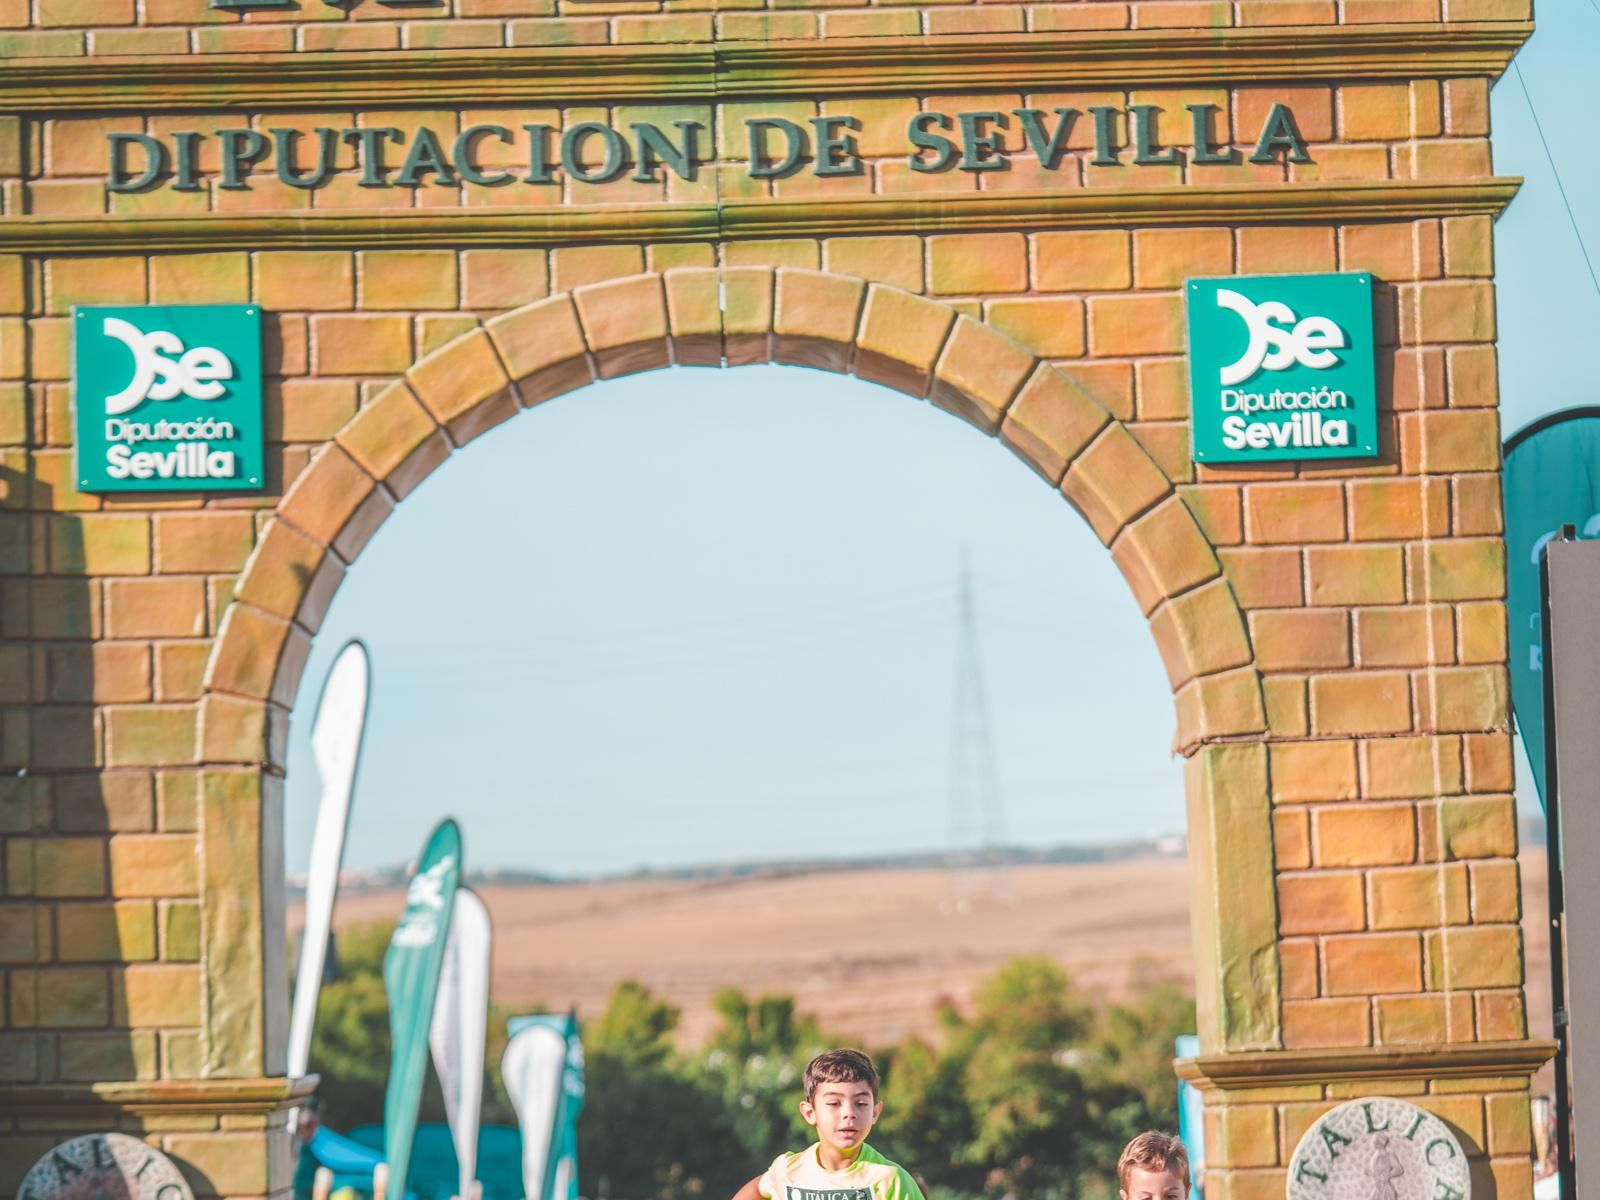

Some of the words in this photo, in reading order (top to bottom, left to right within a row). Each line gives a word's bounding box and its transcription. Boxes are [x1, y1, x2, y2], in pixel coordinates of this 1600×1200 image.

[105, 119, 701, 193] DIPUTACION
[745, 115, 862, 179] DE
[905, 103, 1313, 172] SEVILLA
[1220, 386, 1347, 416] Diputación
[105, 417, 234, 445] Diputación
[1222, 412, 1349, 450] Sevilla
[106, 442, 235, 479] Sevilla
